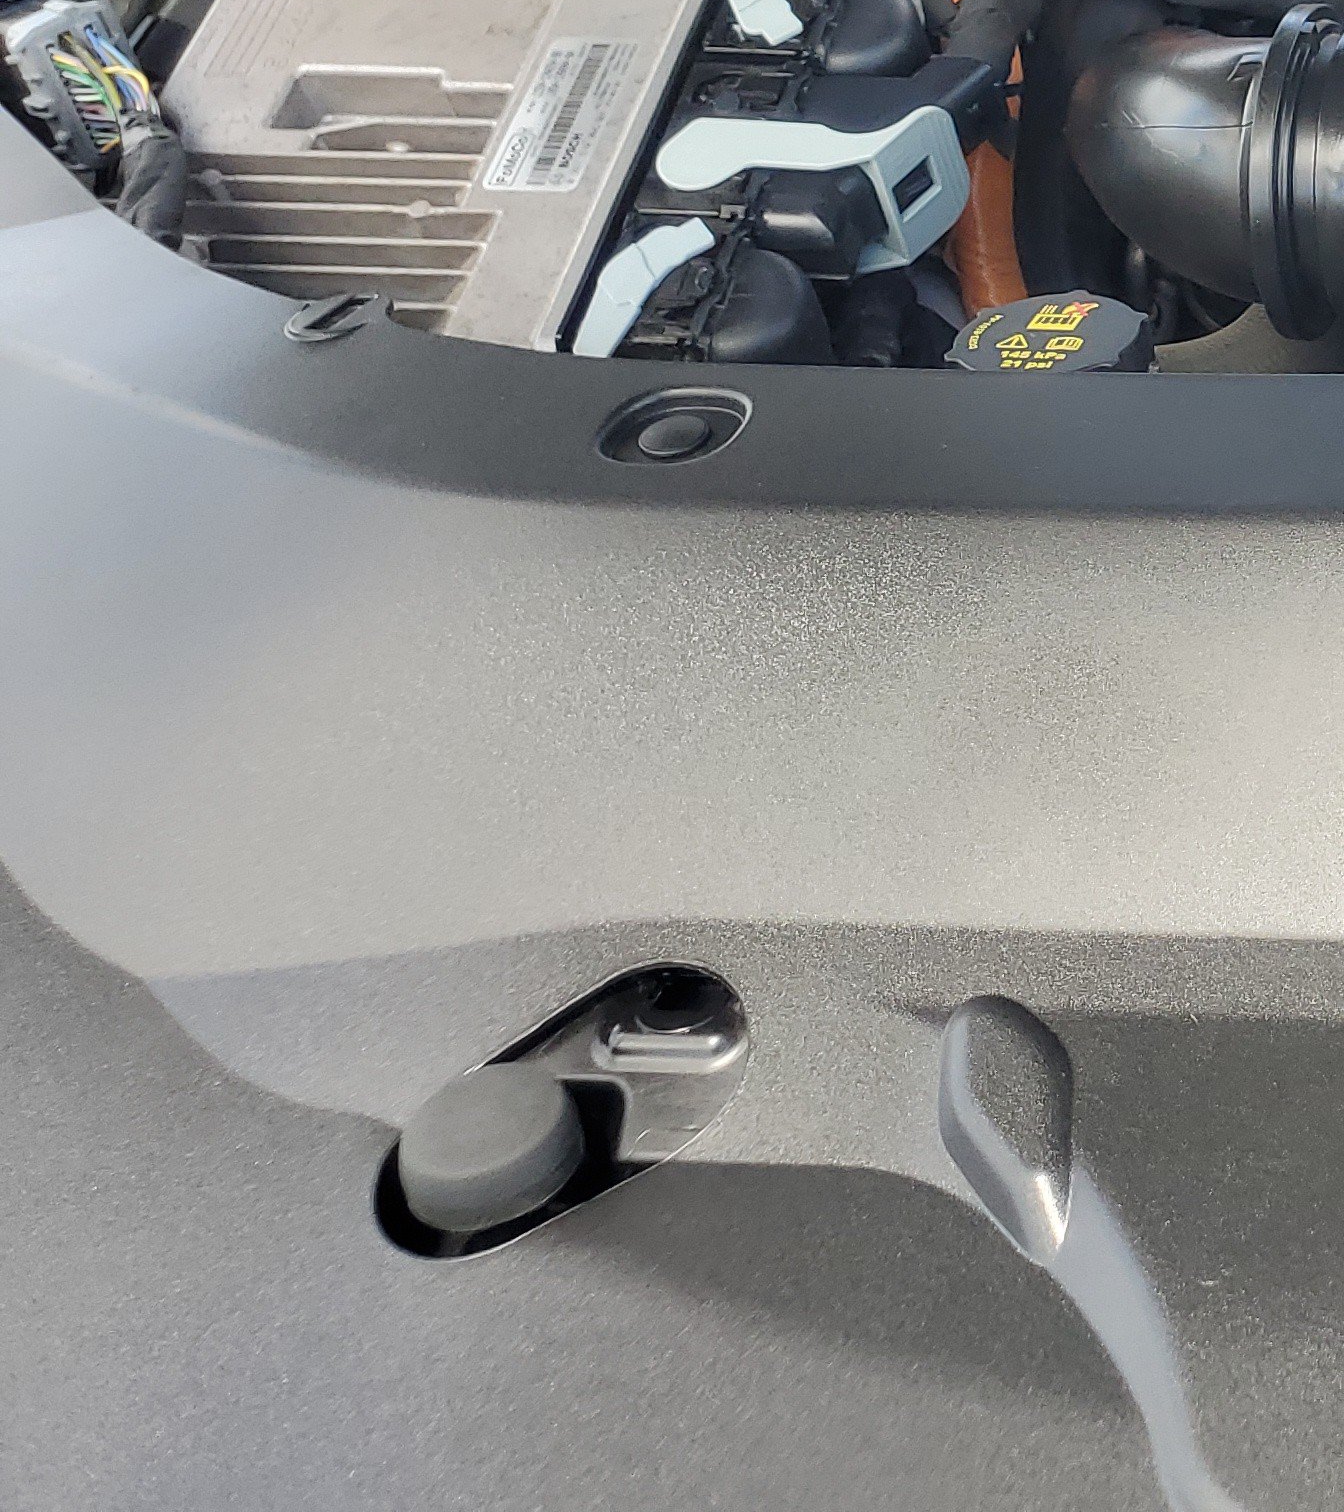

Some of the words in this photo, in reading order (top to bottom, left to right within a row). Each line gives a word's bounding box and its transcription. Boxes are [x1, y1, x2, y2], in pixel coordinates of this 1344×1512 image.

[495, 136, 529, 184] FoMoCo
[558, 133, 582, 168] BOSCH
[1000, 360, 1022, 368] 21
[1024, 361, 1054, 370] psi
[1034, 351, 1066, 359] kPa
